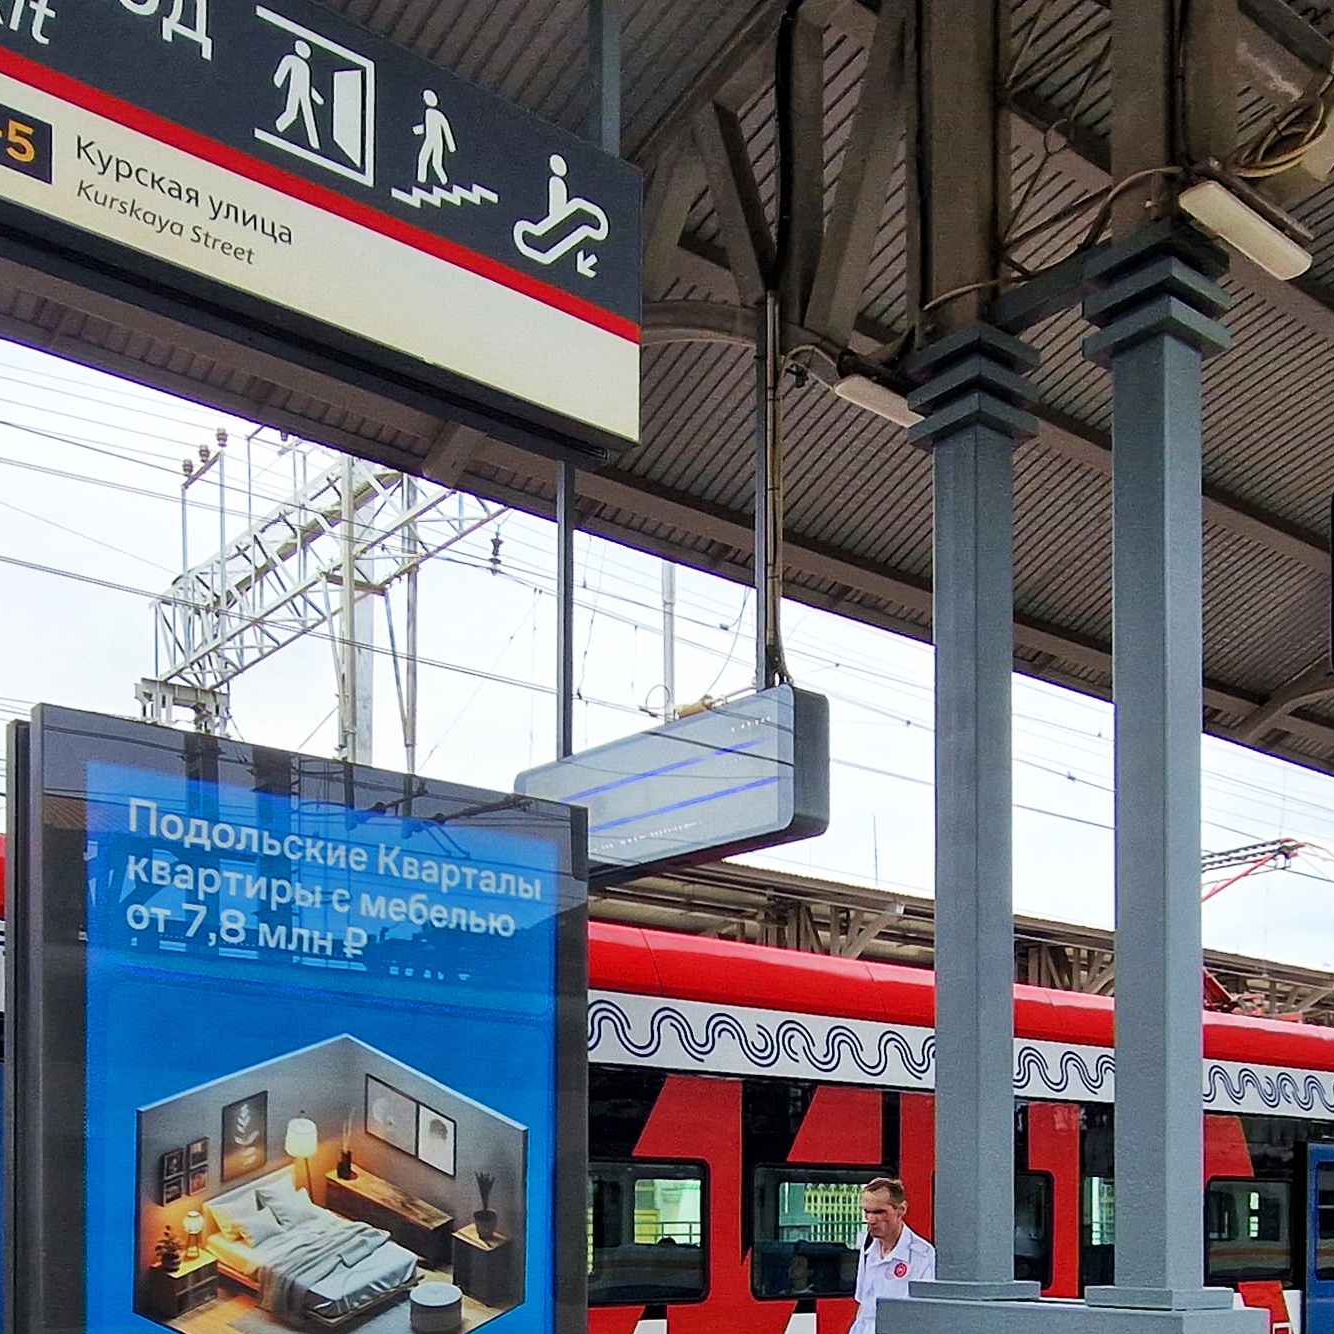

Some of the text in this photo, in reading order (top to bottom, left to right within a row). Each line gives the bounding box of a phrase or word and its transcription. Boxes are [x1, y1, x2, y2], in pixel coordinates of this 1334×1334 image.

[76, 135, 293, 245] Курская улица
[76, 180, 256, 265] Kurskaya Street
[128, 797, 543, 901] Подольские Кварталы
[126, 903, 171, 933] от
[182, 902, 247, 947] 7,8
[258, 922, 333, 956] млн
[127, 854, 516, 937] квартиры с мебелью
